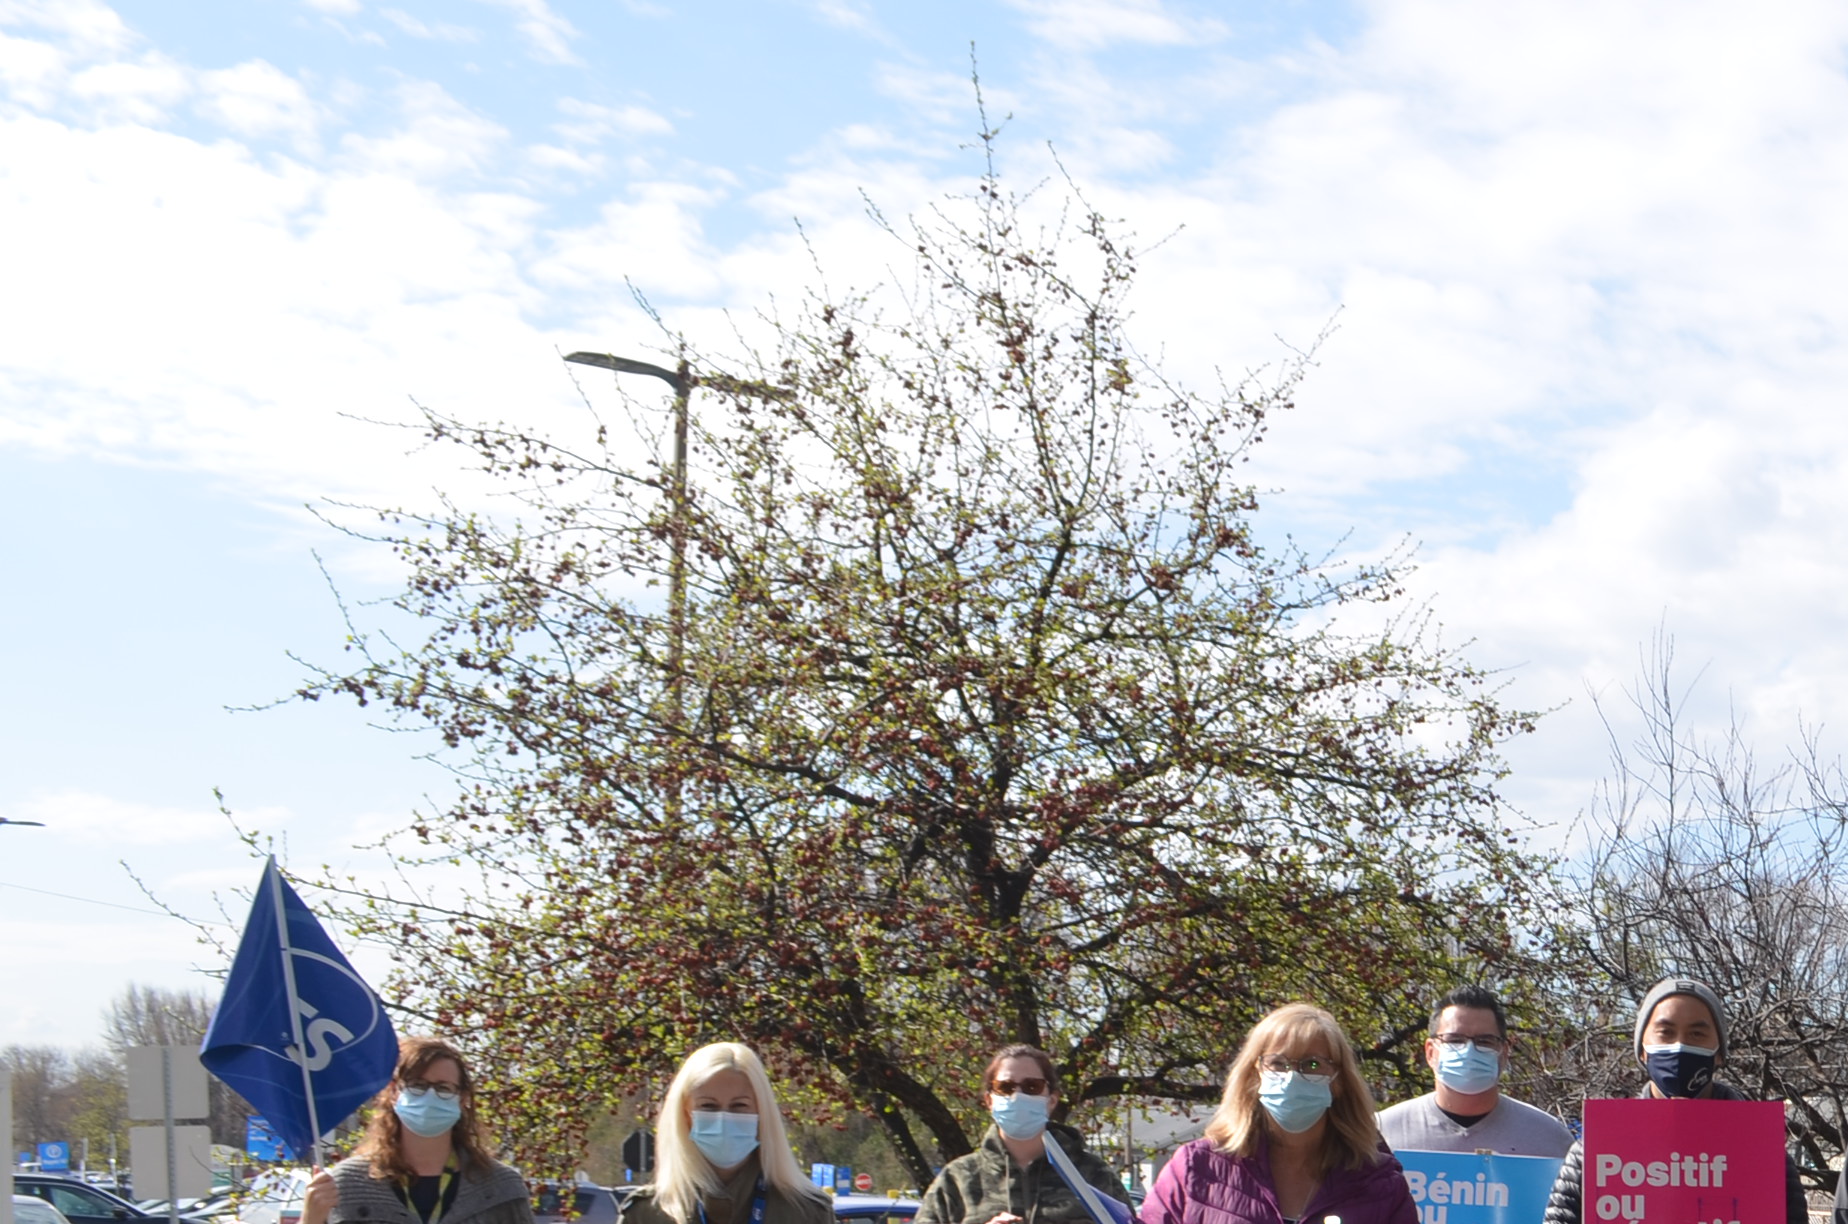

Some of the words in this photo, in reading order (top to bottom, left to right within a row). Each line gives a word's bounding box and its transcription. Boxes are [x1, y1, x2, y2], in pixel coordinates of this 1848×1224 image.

[1596, 1152, 1728, 1187] Positif
[1403, 1170, 1509, 1207] Bénin
[1596, 1195, 1645, 1220] ou
